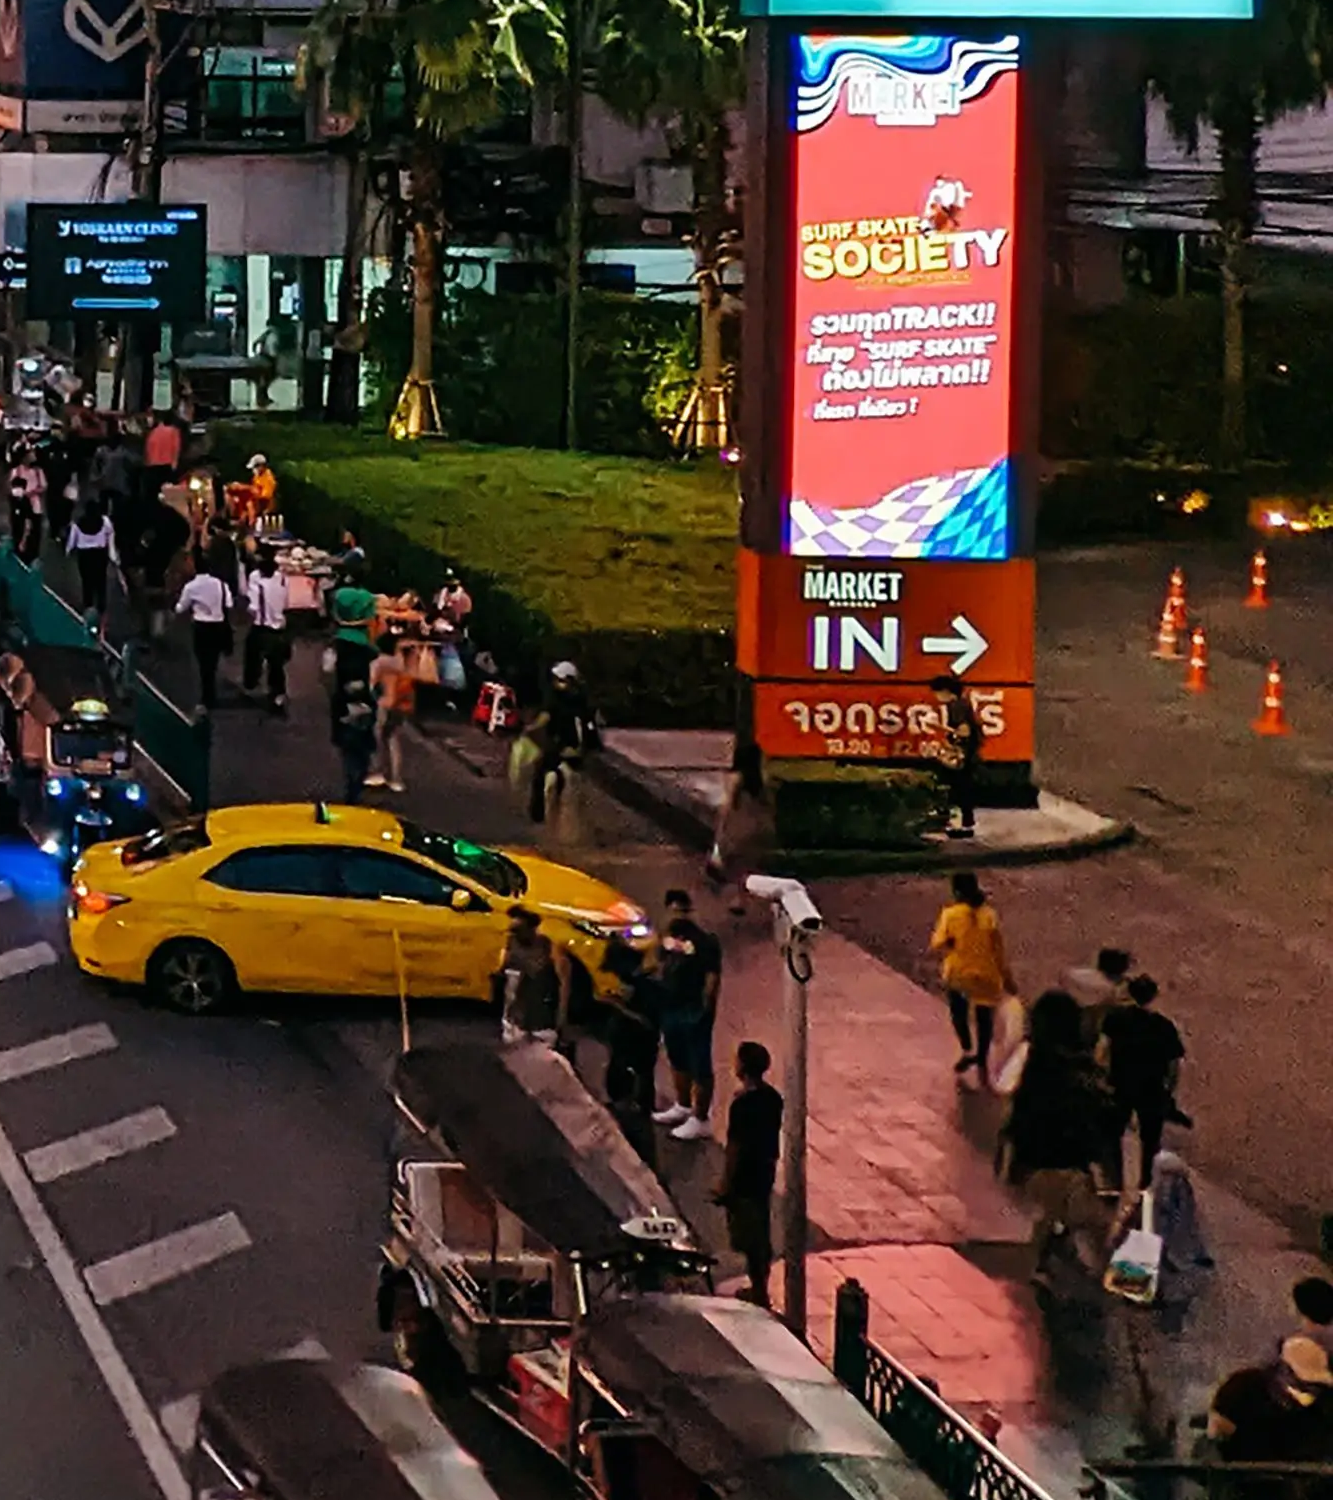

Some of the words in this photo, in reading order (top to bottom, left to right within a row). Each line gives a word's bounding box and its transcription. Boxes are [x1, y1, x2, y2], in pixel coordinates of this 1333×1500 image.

[851, 82, 960, 110] MRKT
[800, 222, 853, 245] SURF
[856, 217, 922, 238] SKATE
[801, 228, 1009, 281] SOCIETY
[803, 571, 903, 601] MARKET
[813, 615, 899, 672] IN
